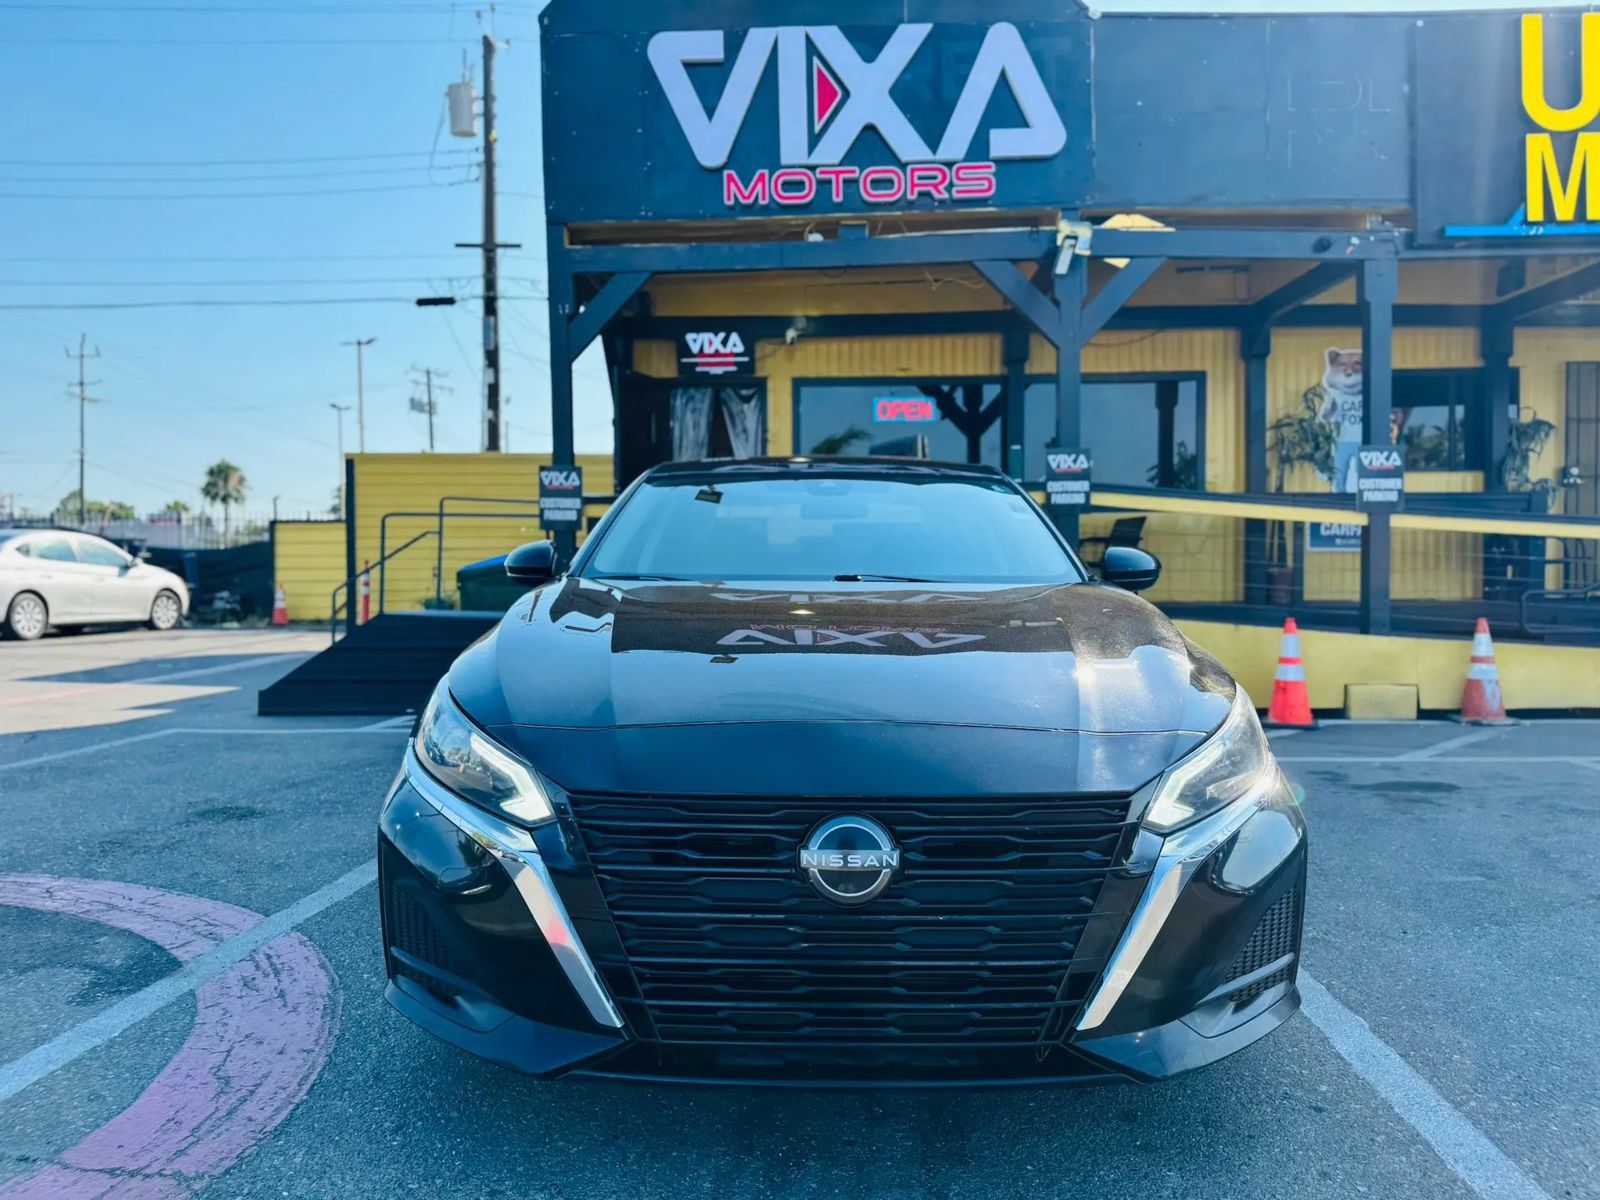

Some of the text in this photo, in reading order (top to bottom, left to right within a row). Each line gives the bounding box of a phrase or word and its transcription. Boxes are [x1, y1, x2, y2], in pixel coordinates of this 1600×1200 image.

[647, 22, 1067, 170] VIXA
[723, 162, 996, 206] MOTORS
[685, 332, 745, 354] VIXA
[877, 400, 933, 420] OPEN
[1047, 454, 1089, 469] VIXA
[1359, 451, 1402, 467] VIXA
[541, 471, 580, 486] VIXA
[803, 853, 897, 867] NISSAN
